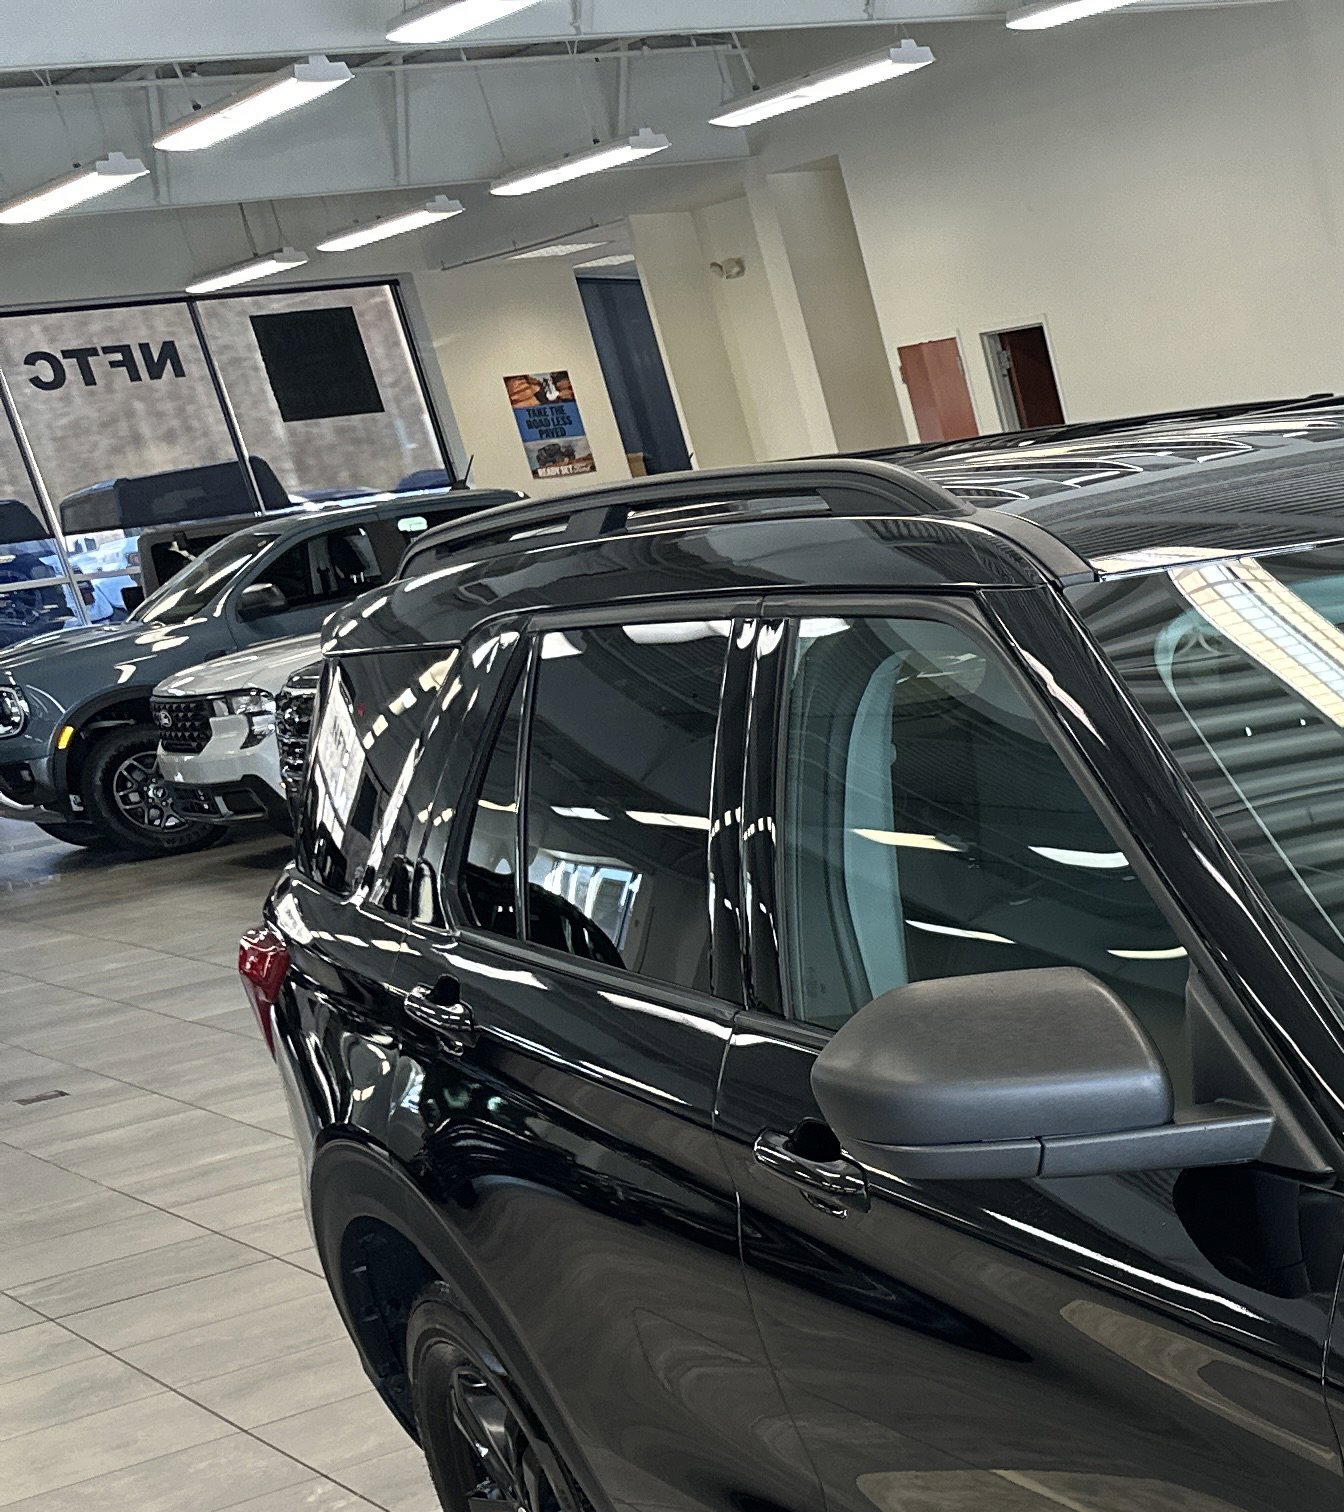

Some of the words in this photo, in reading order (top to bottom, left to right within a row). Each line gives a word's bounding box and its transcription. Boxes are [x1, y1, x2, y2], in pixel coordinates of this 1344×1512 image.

[526, 407, 549, 418] TAKE
[550, 405, 566, 416] THE
[526, 418, 551, 430] ROAD
[551, 415, 573, 427] LESS
[538, 427, 567, 440] PAVED
